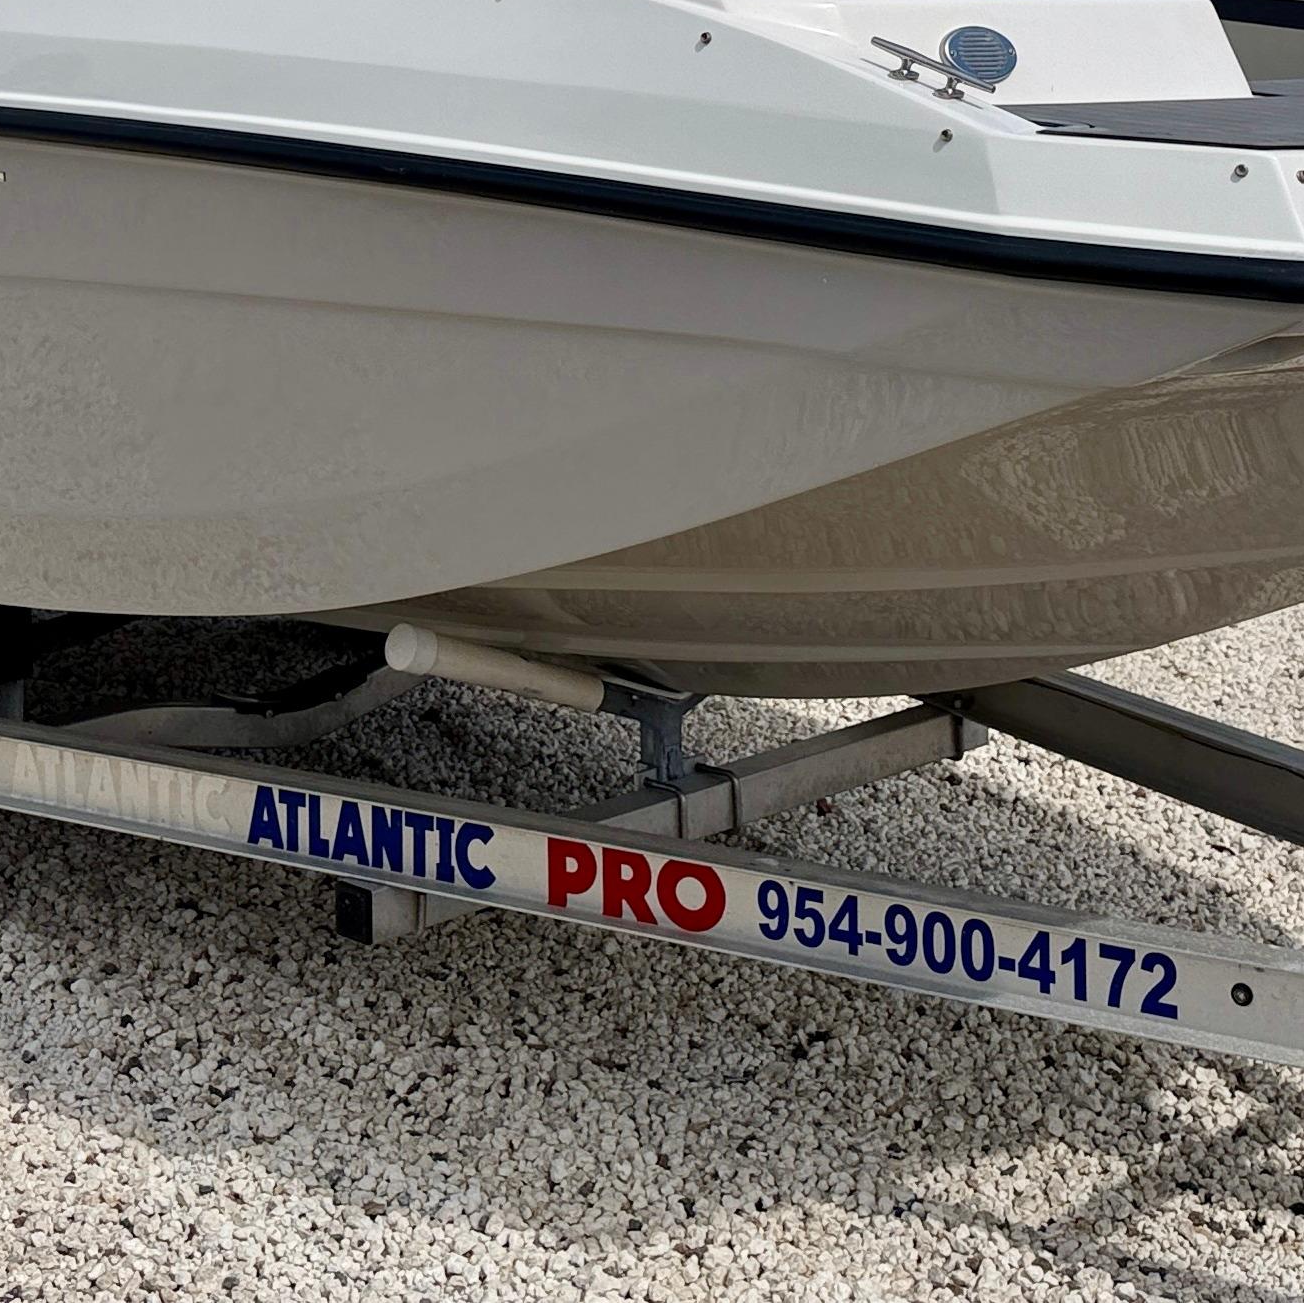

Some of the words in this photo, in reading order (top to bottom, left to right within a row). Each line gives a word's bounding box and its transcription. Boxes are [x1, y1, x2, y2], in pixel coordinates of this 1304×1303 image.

[247, 785, 497, 891] ATLANTIC
[547, 836, 727, 933] PRO
[756, 879, 1180, 1021] 954-900-4172
